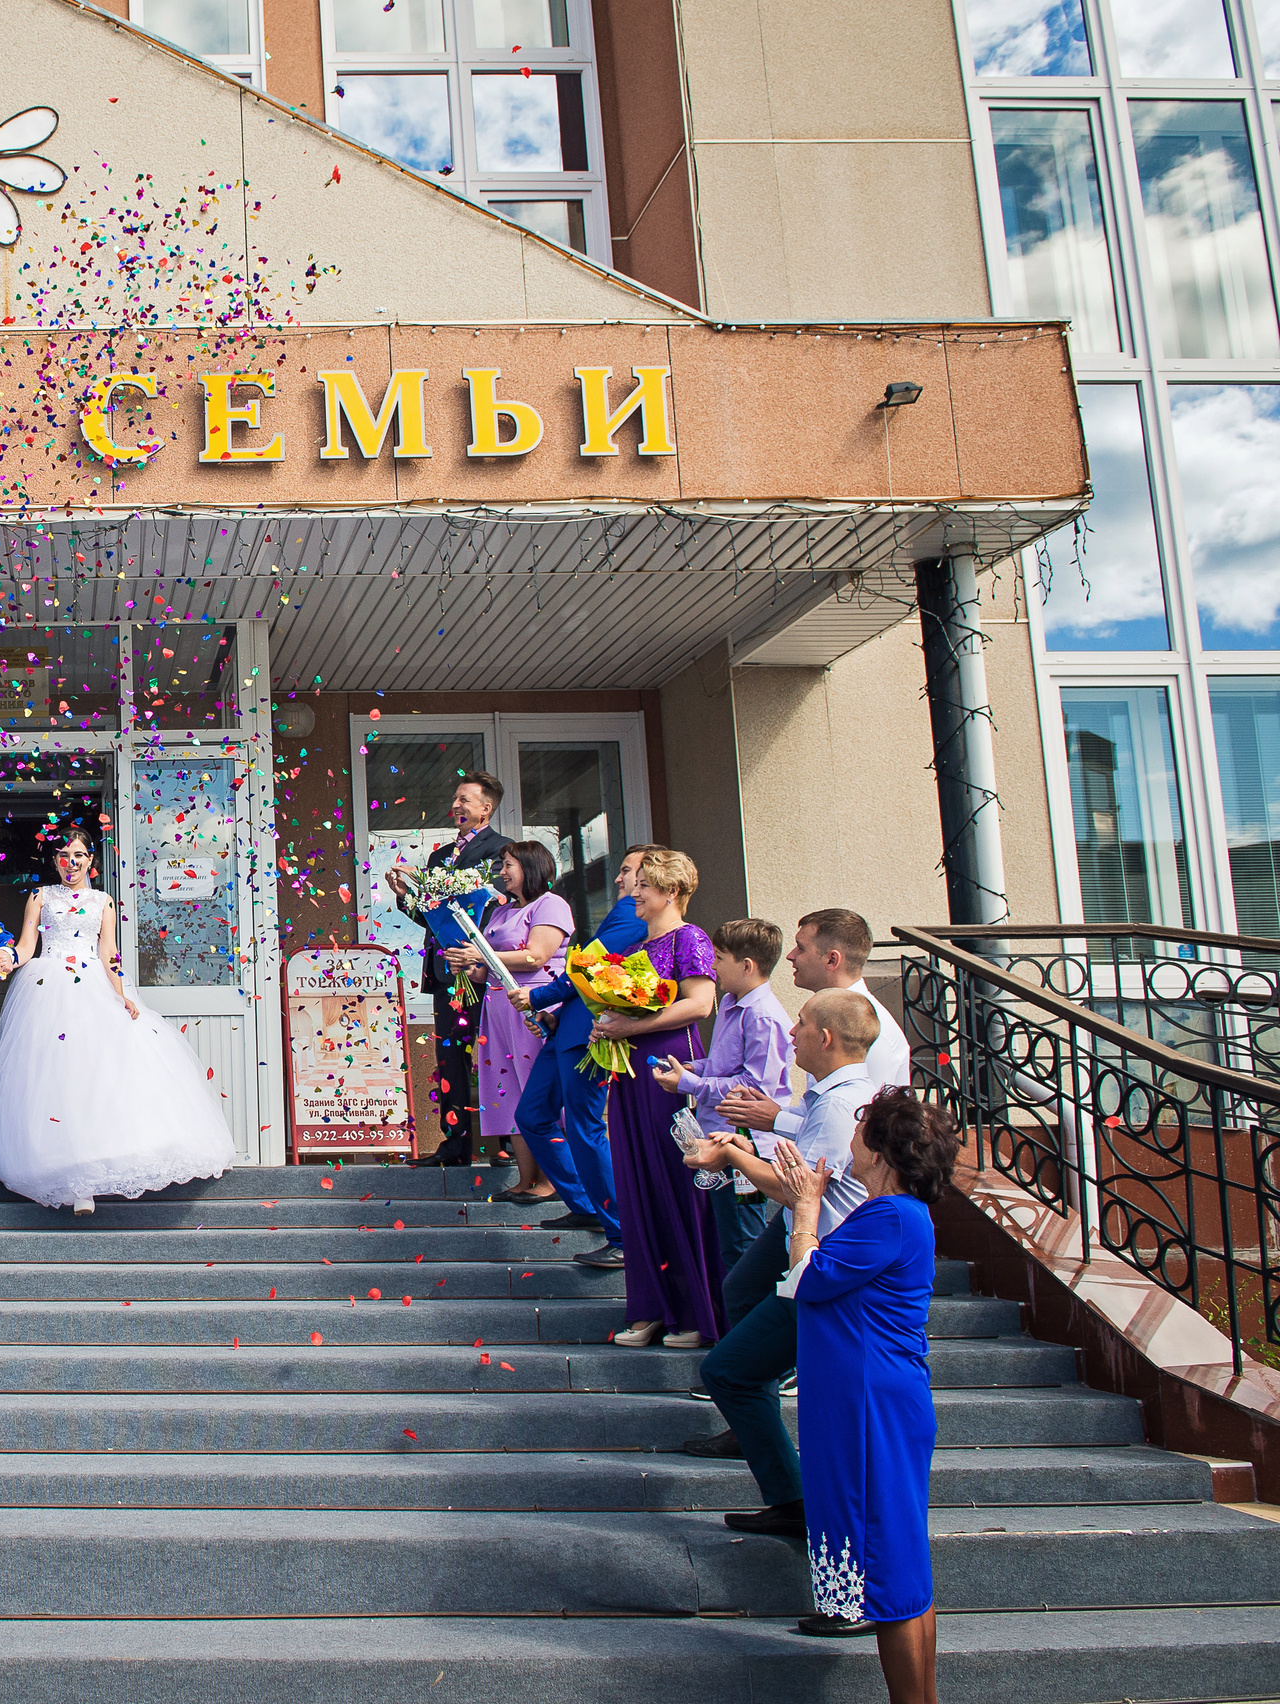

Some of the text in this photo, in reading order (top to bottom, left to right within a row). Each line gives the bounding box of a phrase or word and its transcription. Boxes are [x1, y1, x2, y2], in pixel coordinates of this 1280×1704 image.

[77, 365, 677, 464] СЕМЬИ
[303, 1098, 335, 1107] Здание
[337, 1098, 358, 1107] ЗАГС
[309, 1110, 322, 1118] ул.
[324, 1108, 377, 1118] Спортивная,
[302, 1130, 405, 1141] 8-922-405-95-93
